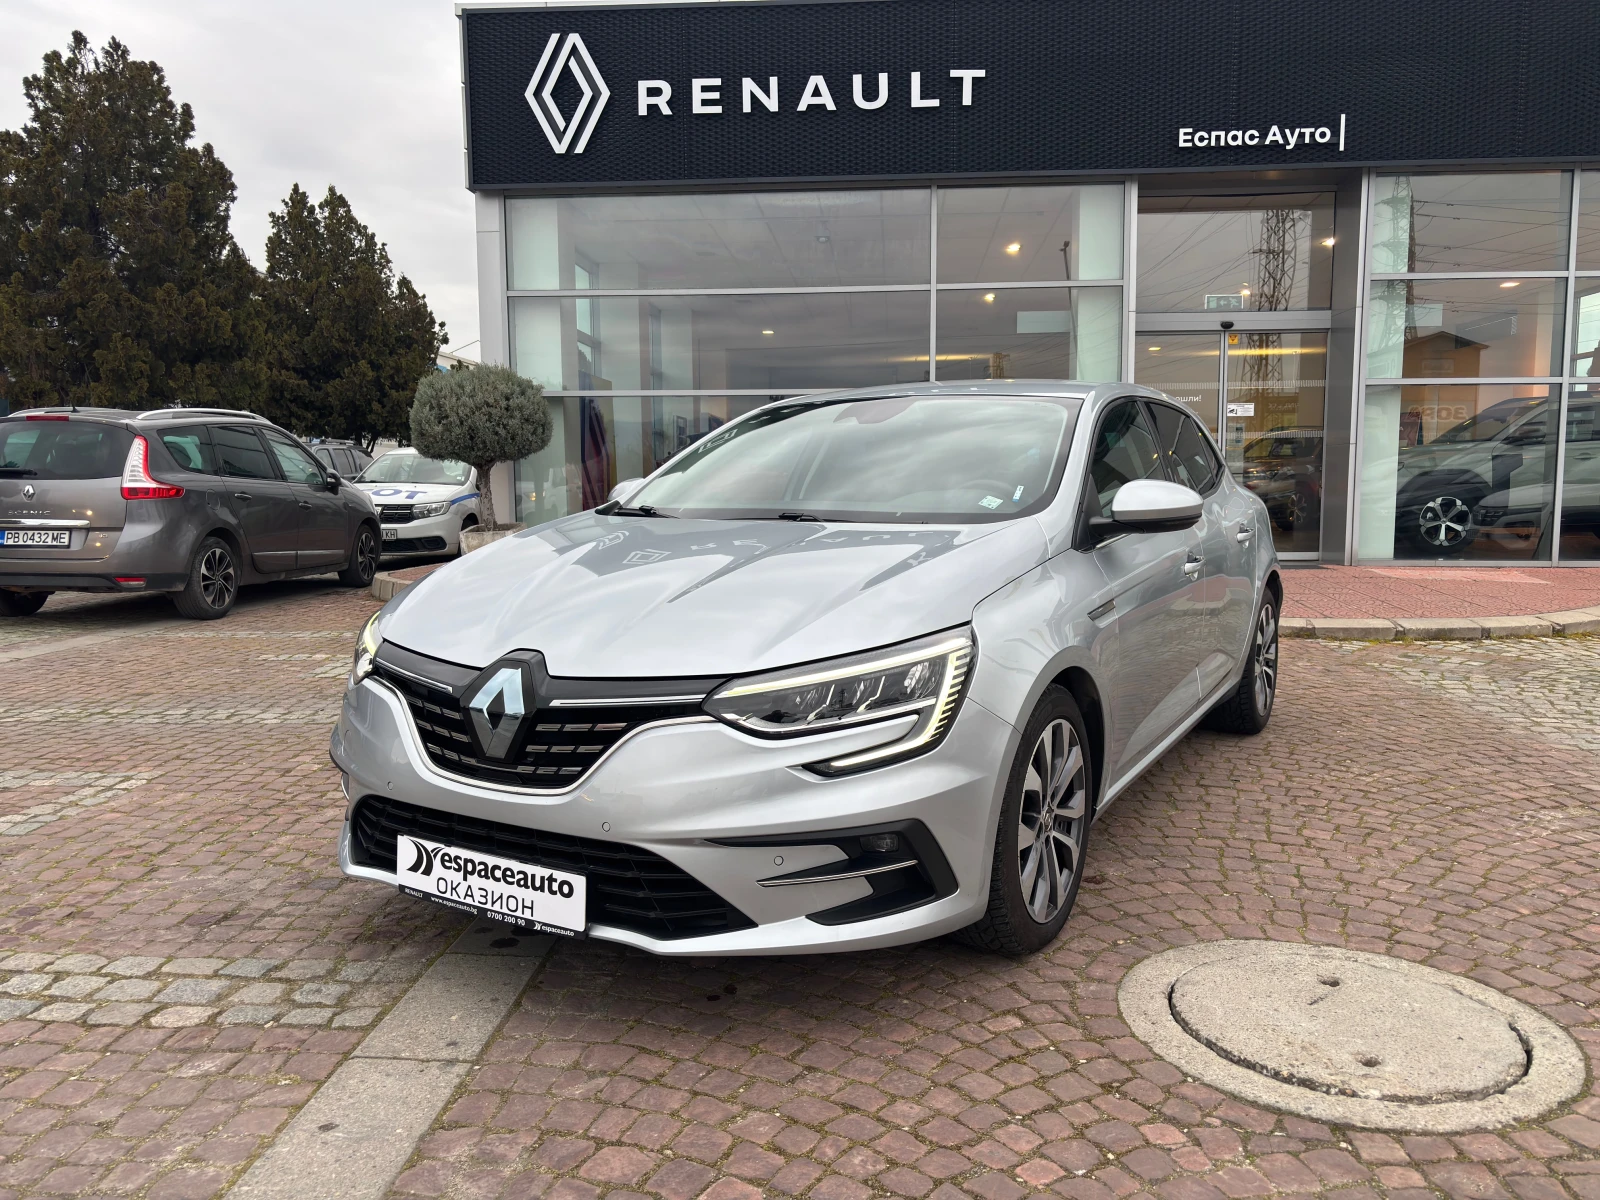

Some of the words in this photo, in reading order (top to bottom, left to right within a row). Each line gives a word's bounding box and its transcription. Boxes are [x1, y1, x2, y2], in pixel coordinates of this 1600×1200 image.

[637, 68, 986, 116] RENAULT
[1178, 128, 1260, 148] Еспас
[1264, 125, 1332, 150] Ауто
[1175, 394, 1202, 402] ошли!
[6, 532, 20, 543] PB
[23, 532, 49, 543] 0432
[51, 532, 67, 543] ME
[440, 851, 575, 899] espaceauto
[430, 896, 478, 914] www.espaceauto.bg
[487, 911, 503, 921] 0700
[504, 914, 516, 924] 200
[517, 918, 526, 926] 90
[541, 924, 575, 937] espaceauto
[436, 877, 535, 917] ОКАЗИОН
